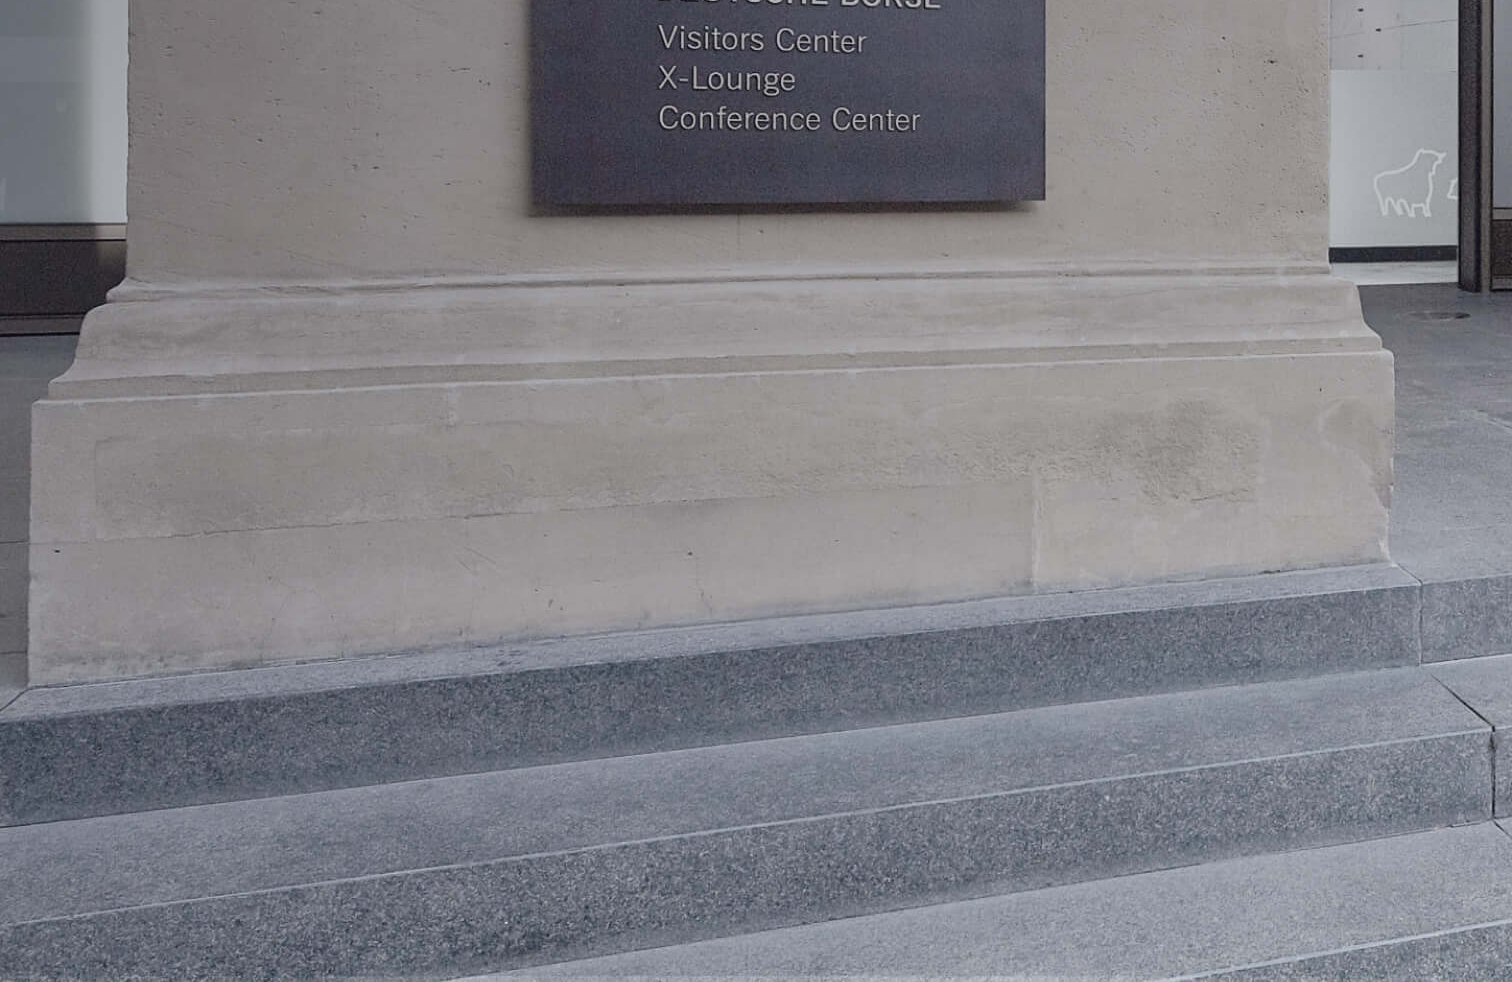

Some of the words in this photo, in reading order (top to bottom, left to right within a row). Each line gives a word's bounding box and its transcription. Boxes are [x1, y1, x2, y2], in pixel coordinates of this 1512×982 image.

[658, 24, 765, 51] Visitors
[775, 27, 867, 53] Center
[658, 65, 796, 97] X-Lounge
[658, 105, 822, 131] Conference
[832, 107, 921, 132] Center
